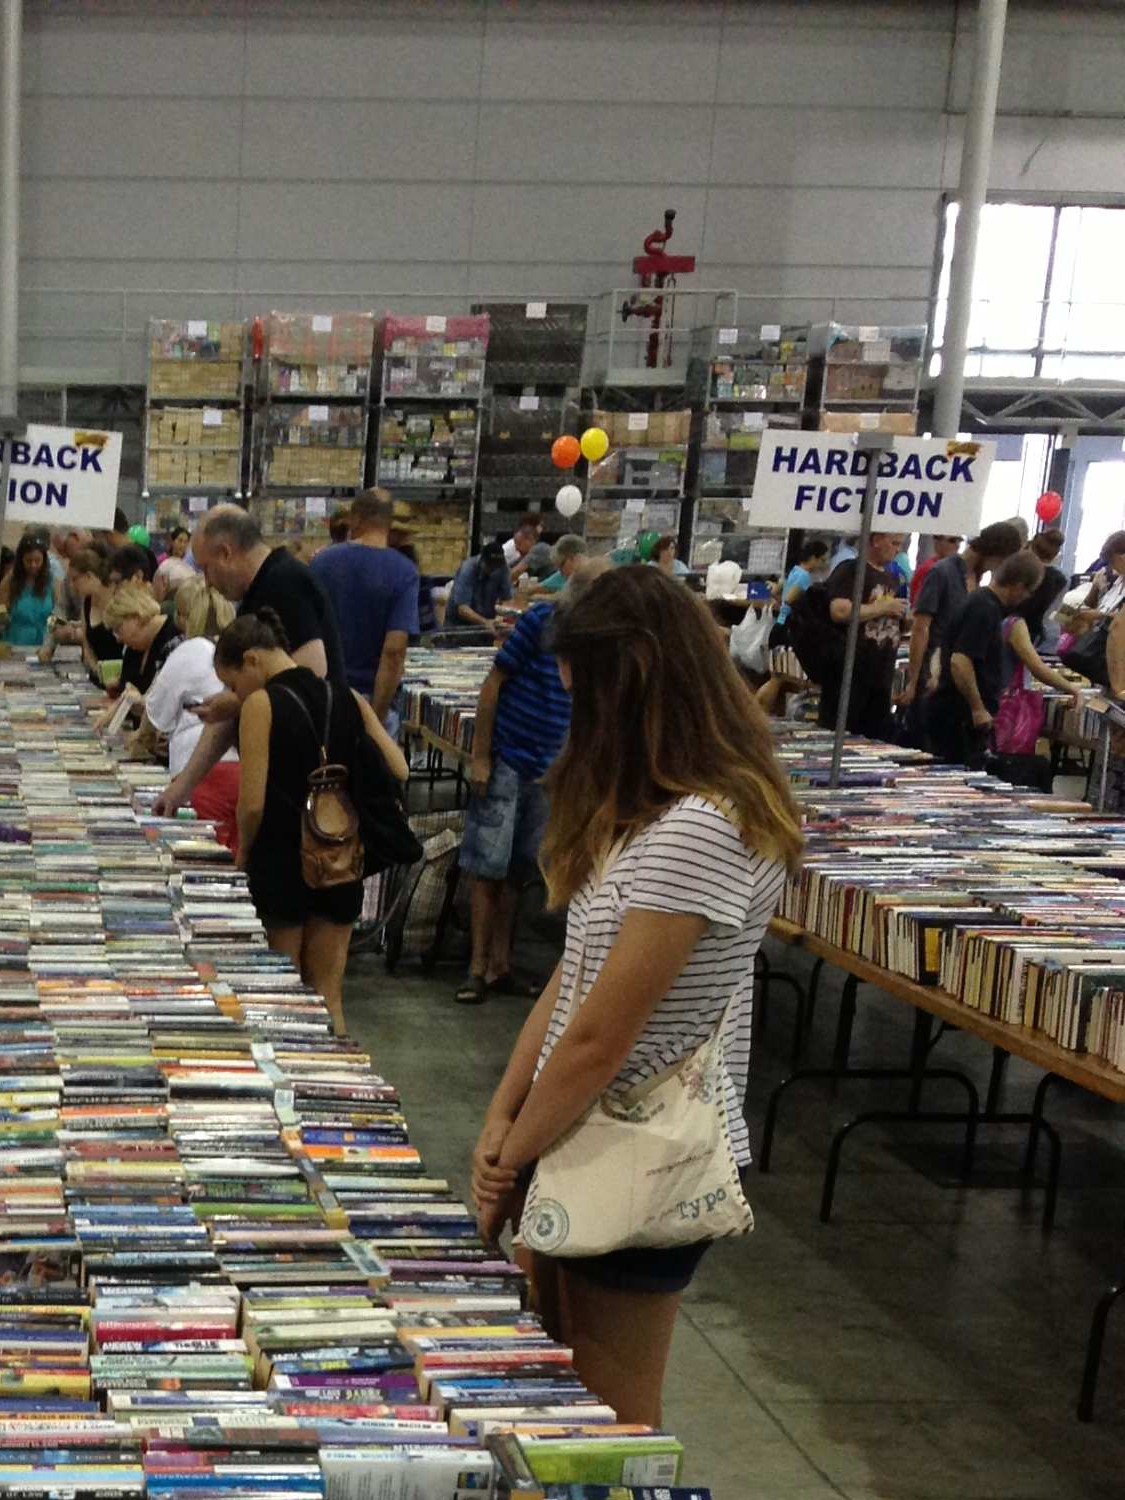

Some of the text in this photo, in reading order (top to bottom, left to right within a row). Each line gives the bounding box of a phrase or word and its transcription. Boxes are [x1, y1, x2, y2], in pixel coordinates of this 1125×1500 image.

[773, 446, 974, 482] HARDBACK
[794, 485, 943, 518] FICTION
[676, 1186, 727, 1221] Typo
